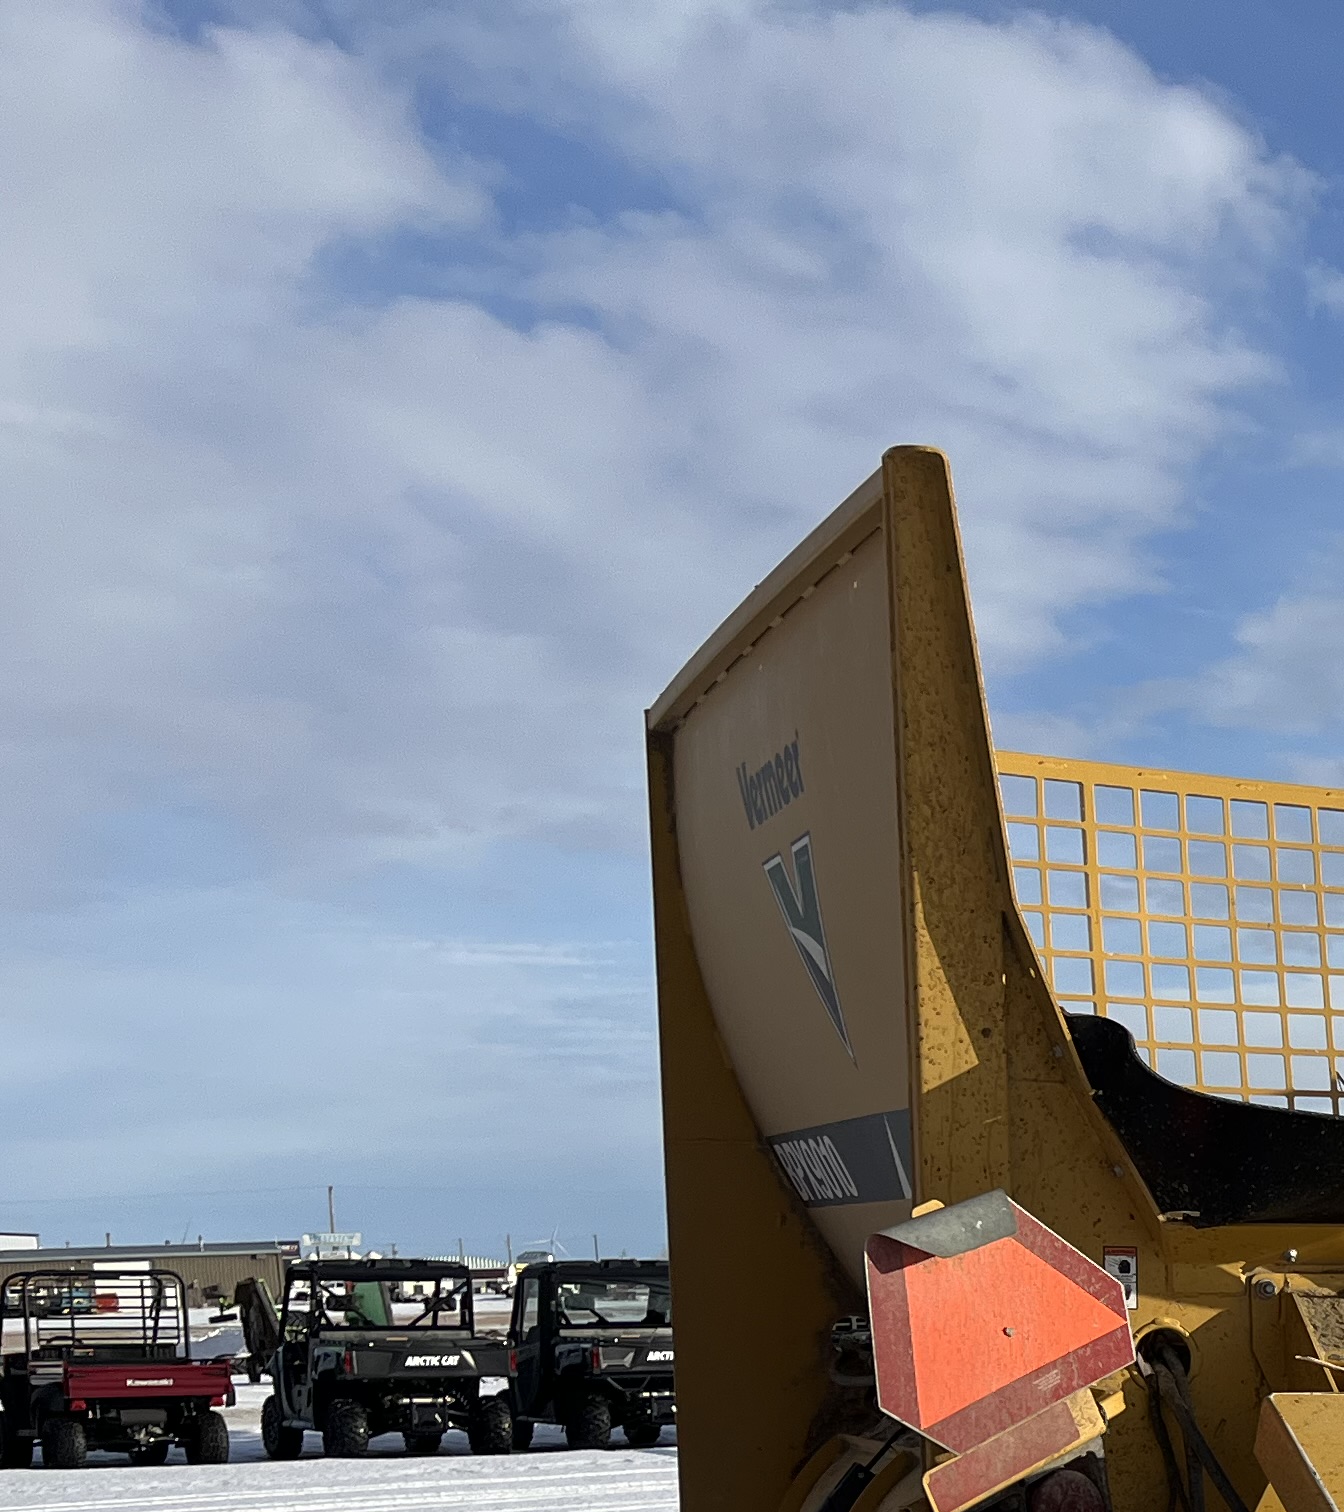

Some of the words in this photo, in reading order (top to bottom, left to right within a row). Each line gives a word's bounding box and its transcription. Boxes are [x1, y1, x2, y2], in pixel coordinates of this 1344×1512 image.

[736, 740, 804, 831] Vermeer
[772, 1135, 859, 1202] BPX9010
[404, 1355, 441, 1367] ARCTIC
[441, 1355, 461, 1366] CAT
